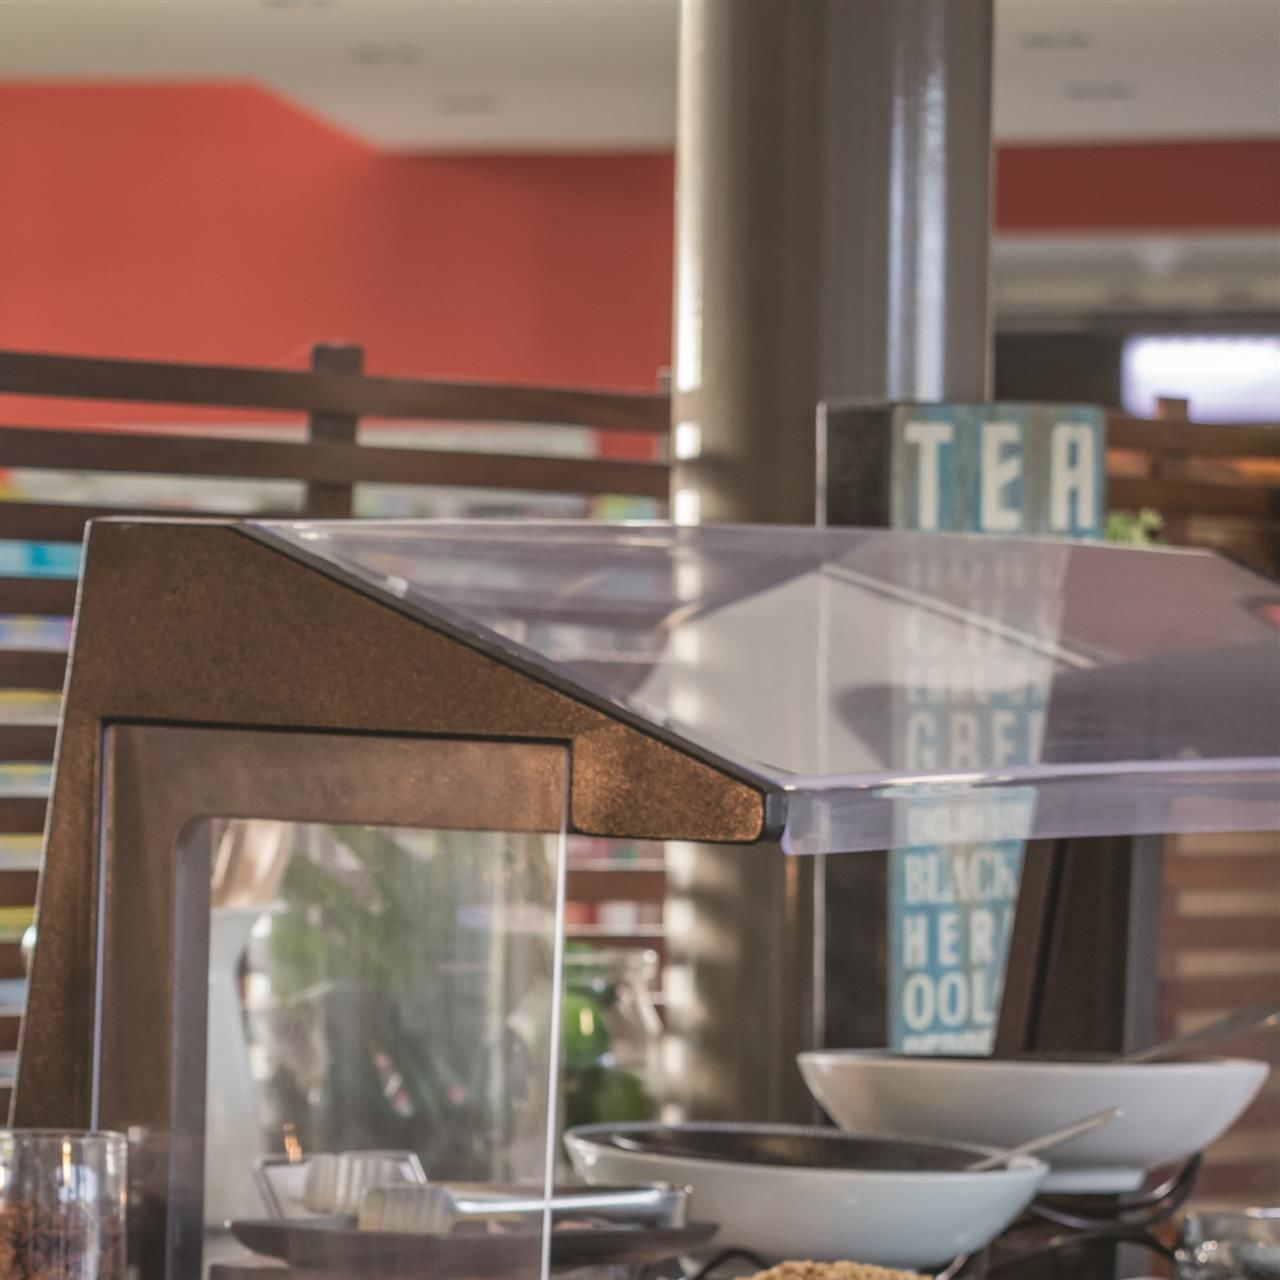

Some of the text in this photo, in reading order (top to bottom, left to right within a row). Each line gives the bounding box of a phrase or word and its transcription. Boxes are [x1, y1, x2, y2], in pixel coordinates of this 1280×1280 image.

[902, 420, 1097, 532] TEA
[902, 908, 1011, 969] HER
[903, 970, 1000, 1032] OOL
